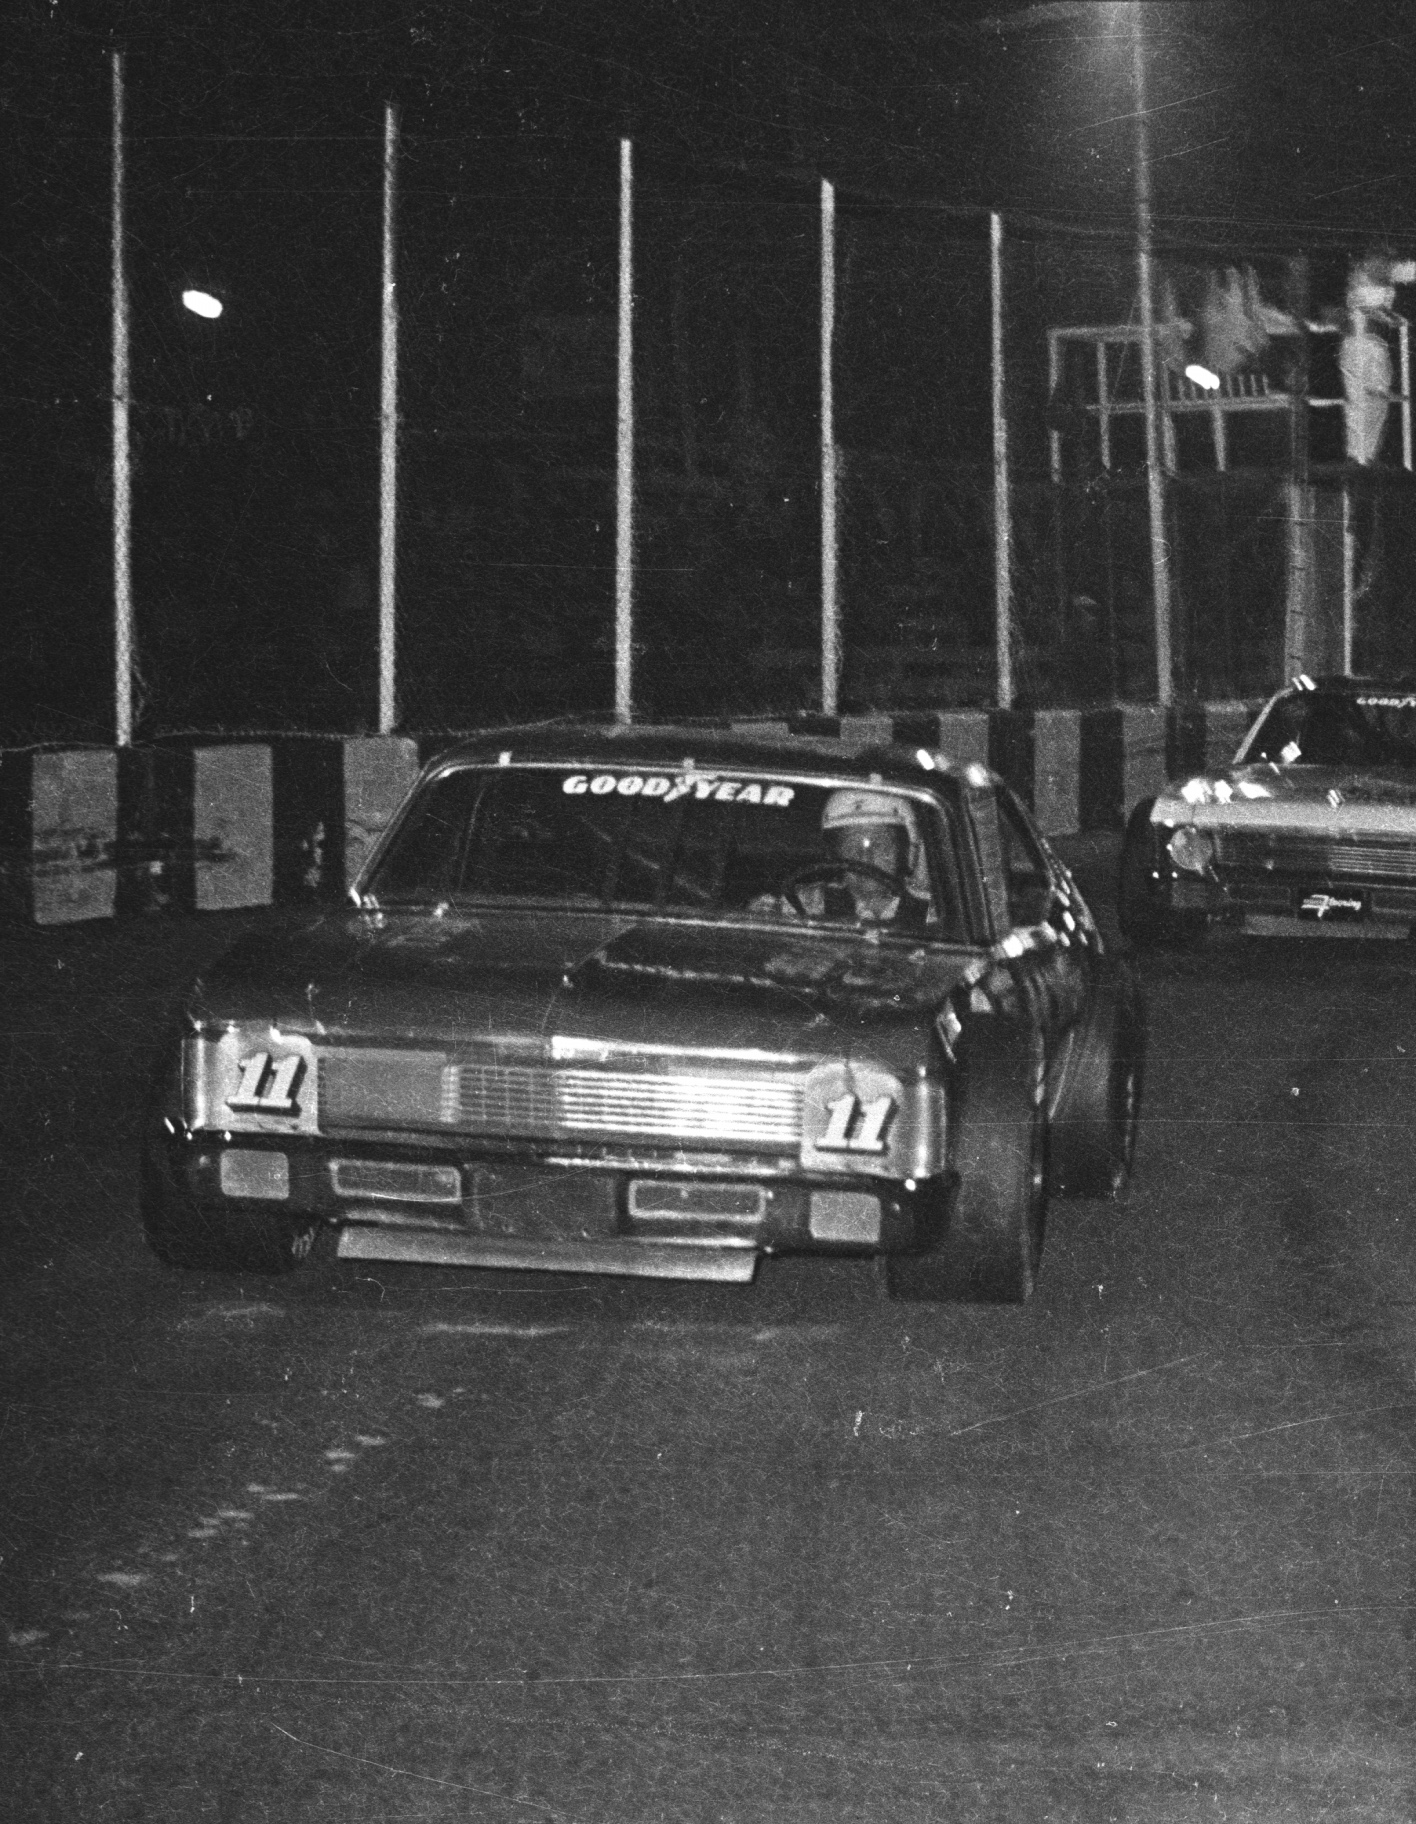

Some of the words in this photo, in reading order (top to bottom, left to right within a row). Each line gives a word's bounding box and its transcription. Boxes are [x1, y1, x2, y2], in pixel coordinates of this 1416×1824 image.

[562, 774, 795, 806] GOODYEAR
[225, 1051, 304, 1117] 11
[815, 1094, 896, 1156] 11
